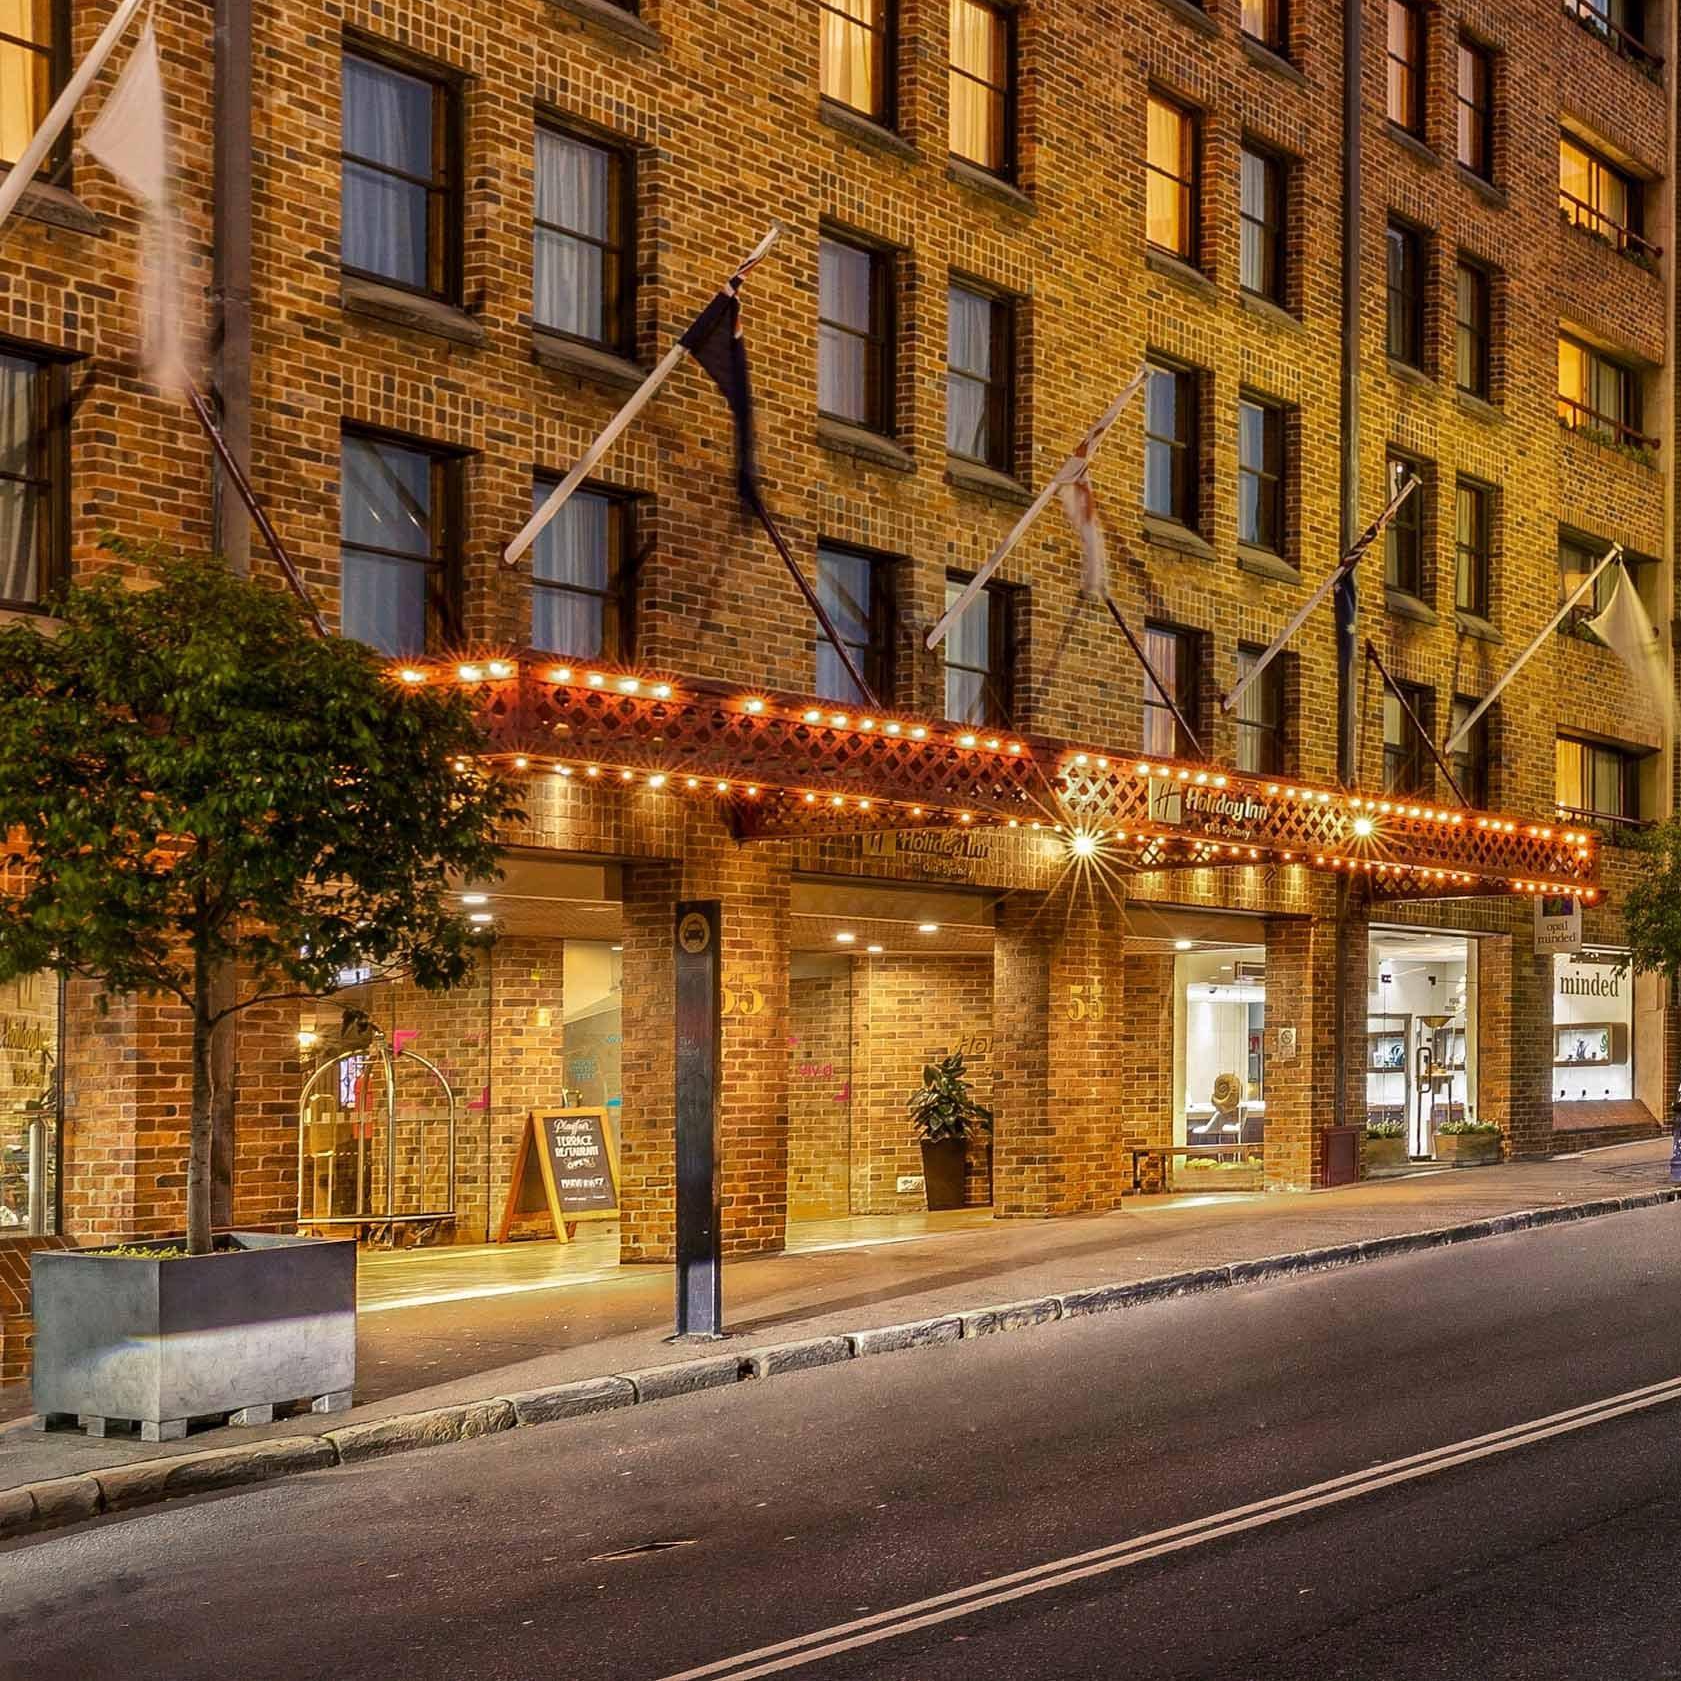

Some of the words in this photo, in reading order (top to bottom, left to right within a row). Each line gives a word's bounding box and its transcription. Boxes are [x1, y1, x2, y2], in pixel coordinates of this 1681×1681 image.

[1185, 786, 1243, 821] Holiday
[1244, 796, 1268, 820] Inn
[899, 830, 966, 859] Holiday
[1546, 920, 1568, 934] opal
[1537, 931, 1577, 944] minded
[1559, 970, 1619, 997] minded
[1068, 985, 1104, 1021] 55
[556, 1136, 593, 1147] TERRACE
[554, 1146, 599, 1158] RESTAURANT
